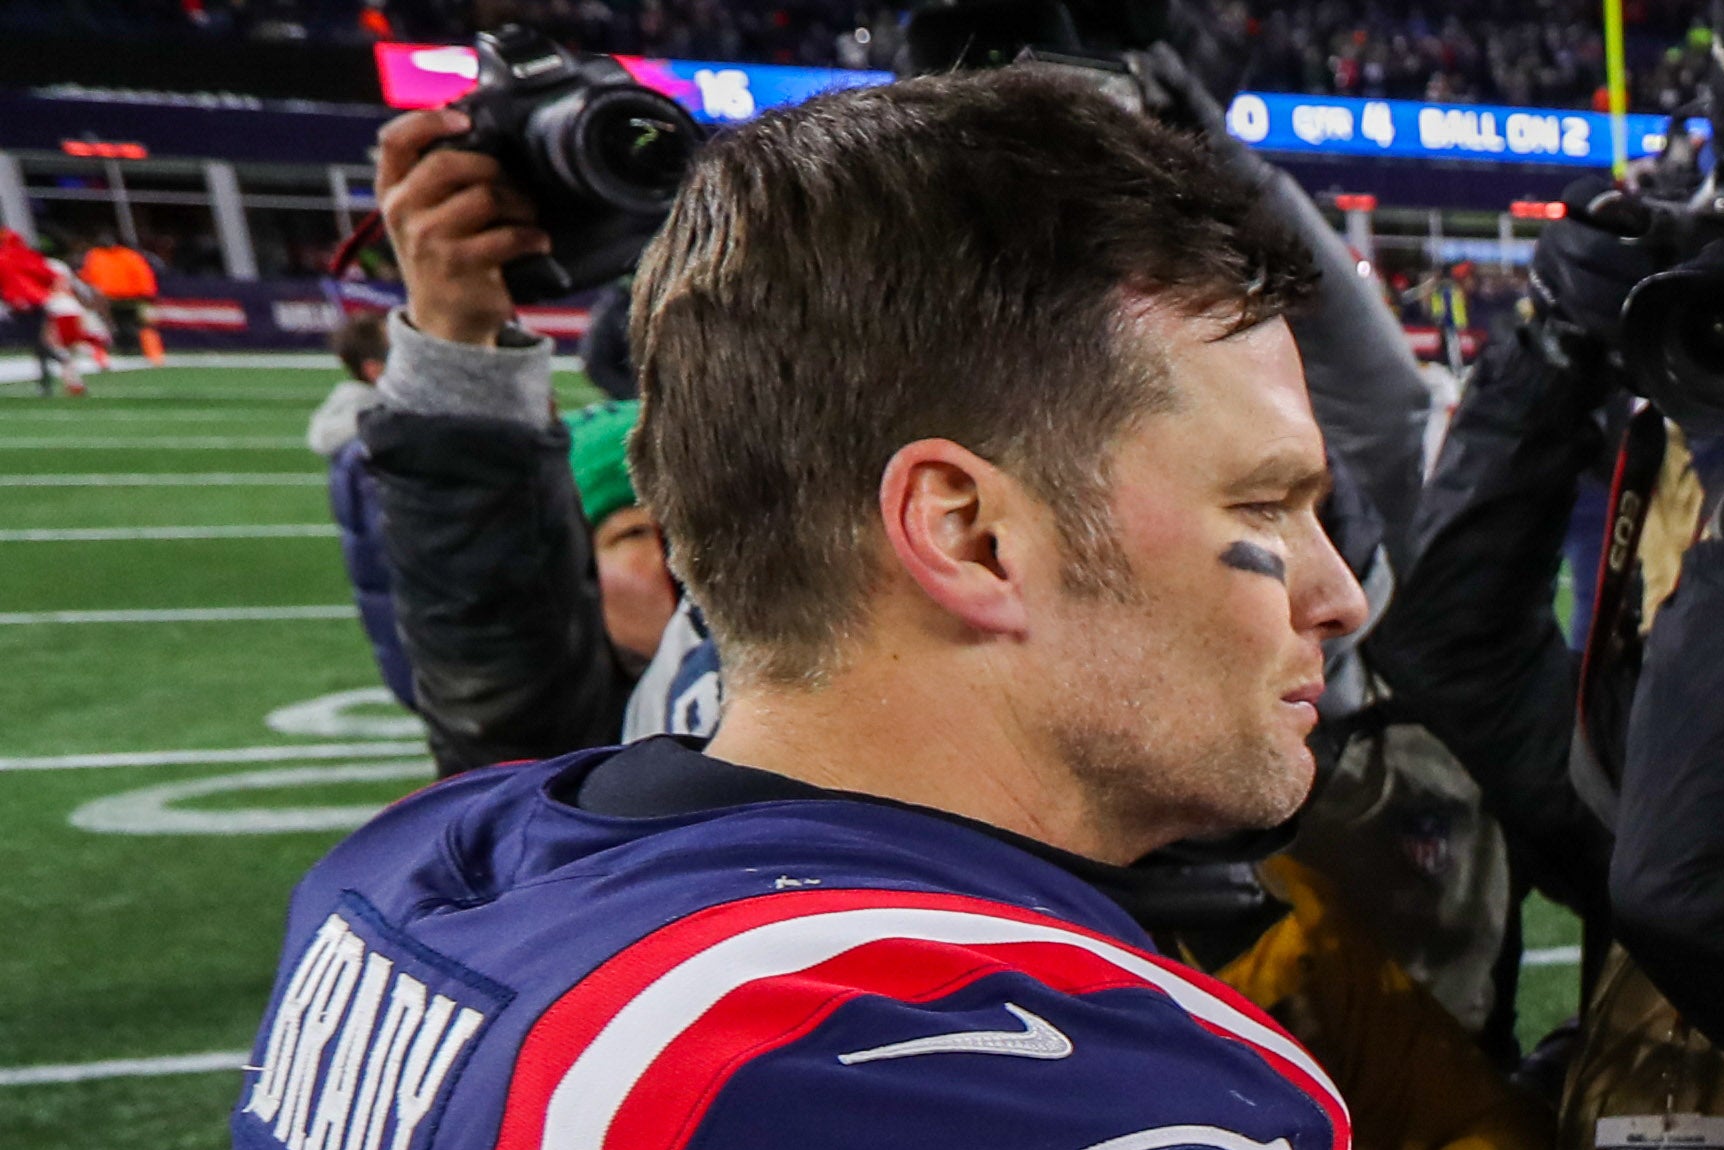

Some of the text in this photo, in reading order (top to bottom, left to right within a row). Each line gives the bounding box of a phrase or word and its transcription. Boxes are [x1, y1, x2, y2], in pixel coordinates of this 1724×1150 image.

[1361, 102, 1395, 147] 4
[1418, 108, 1504, 152] BALL
[1506, 114, 1560, 154] ON
[1562, 117, 1590, 157] 2
